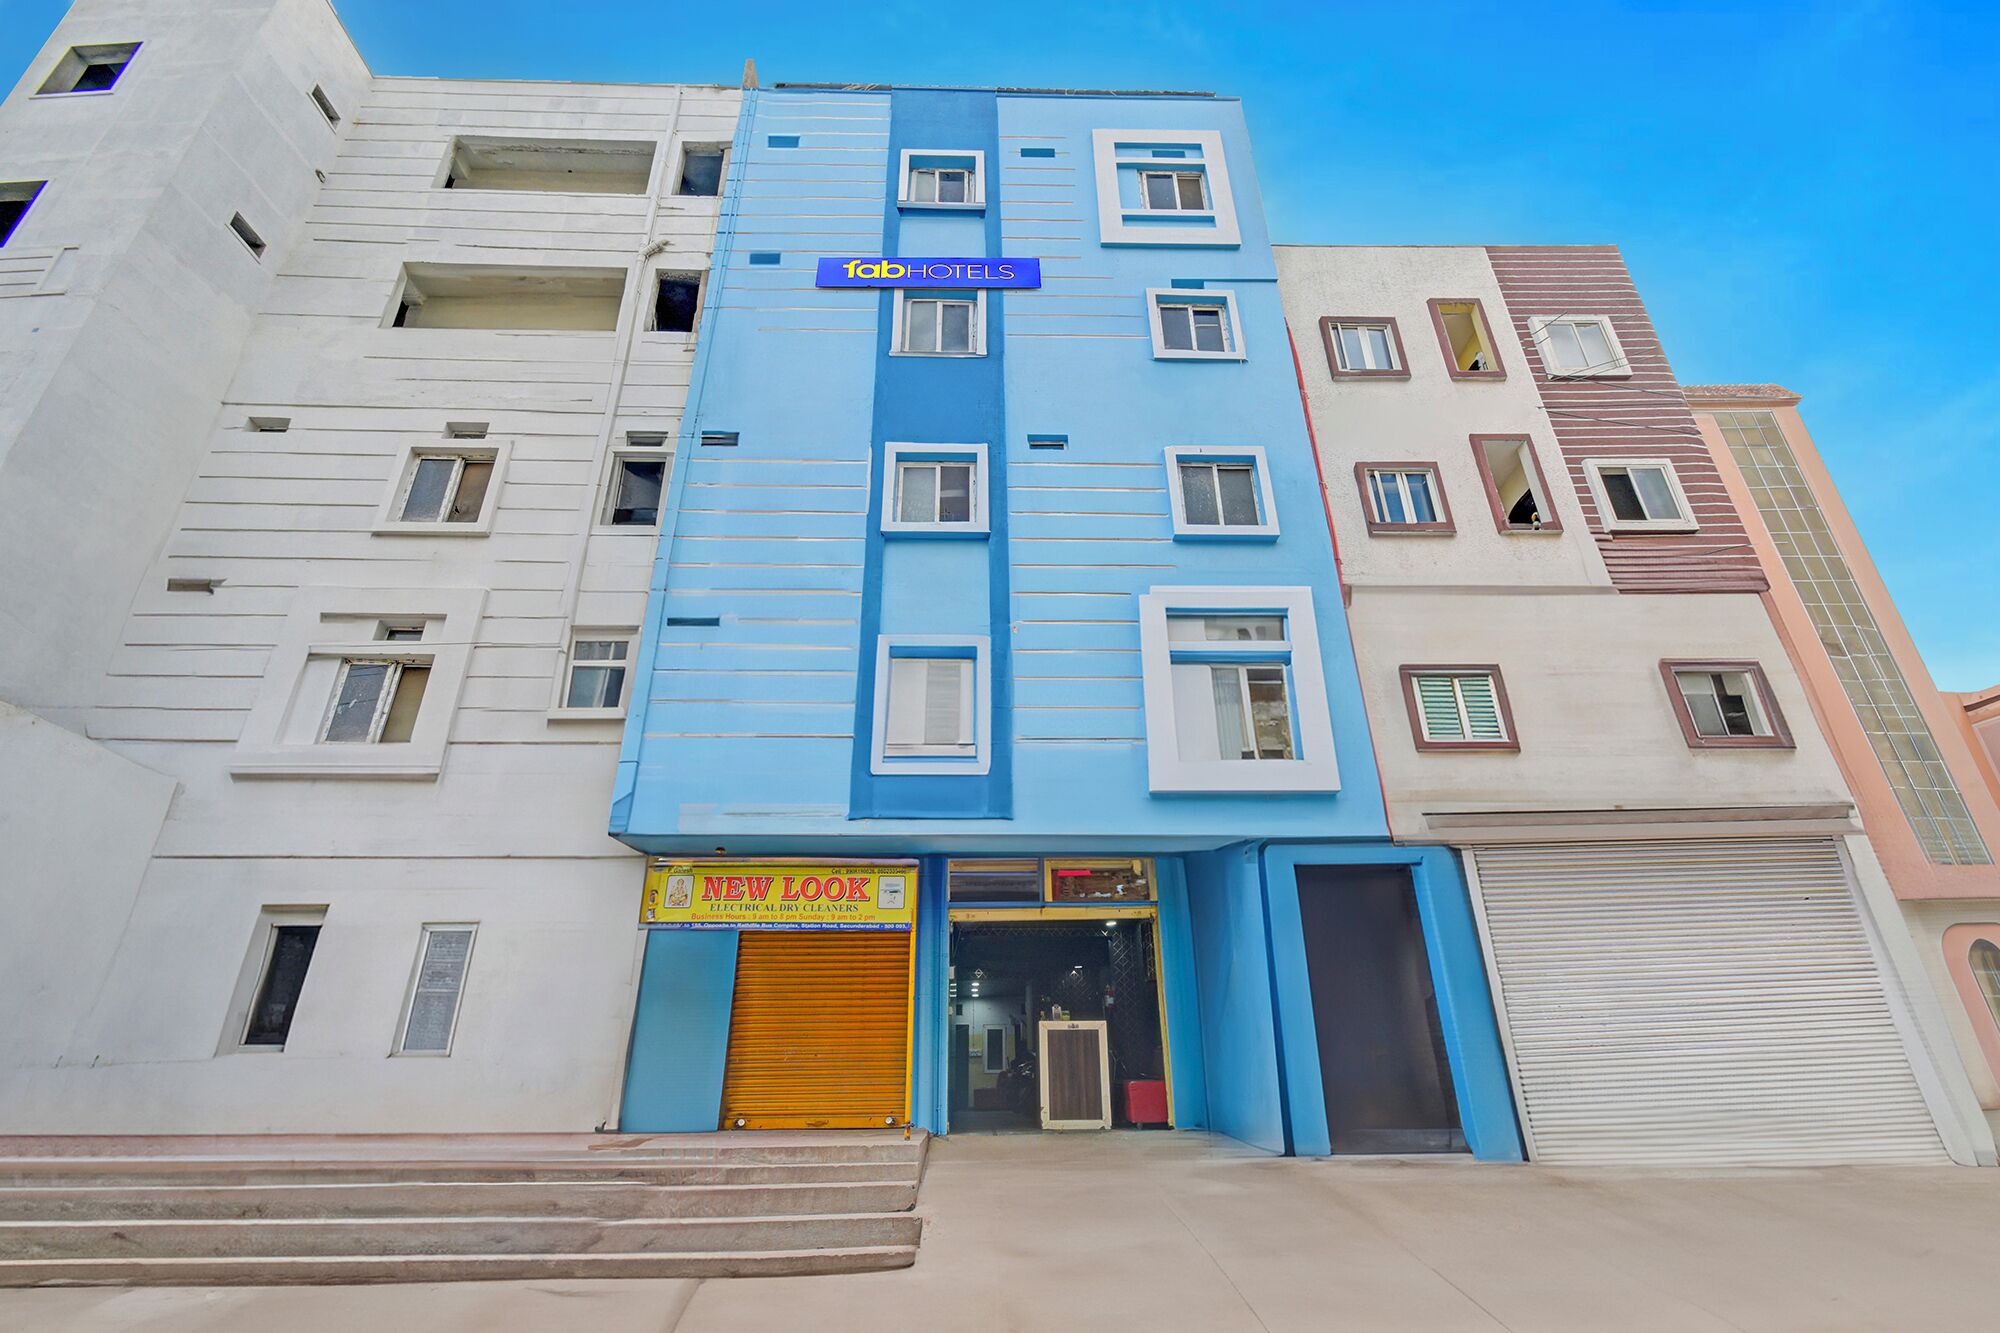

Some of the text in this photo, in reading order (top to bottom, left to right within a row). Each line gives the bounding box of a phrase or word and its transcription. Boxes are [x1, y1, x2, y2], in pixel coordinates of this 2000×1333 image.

[701, 875, 870, 902] NEW LOOK
[710, 903, 859, 912] ELECTRICAL DRY CLEANERS
[786, 914, 797, 922] pm
[799, 913, 825, 922] Sunday
[864, 914, 875, 922] pm
